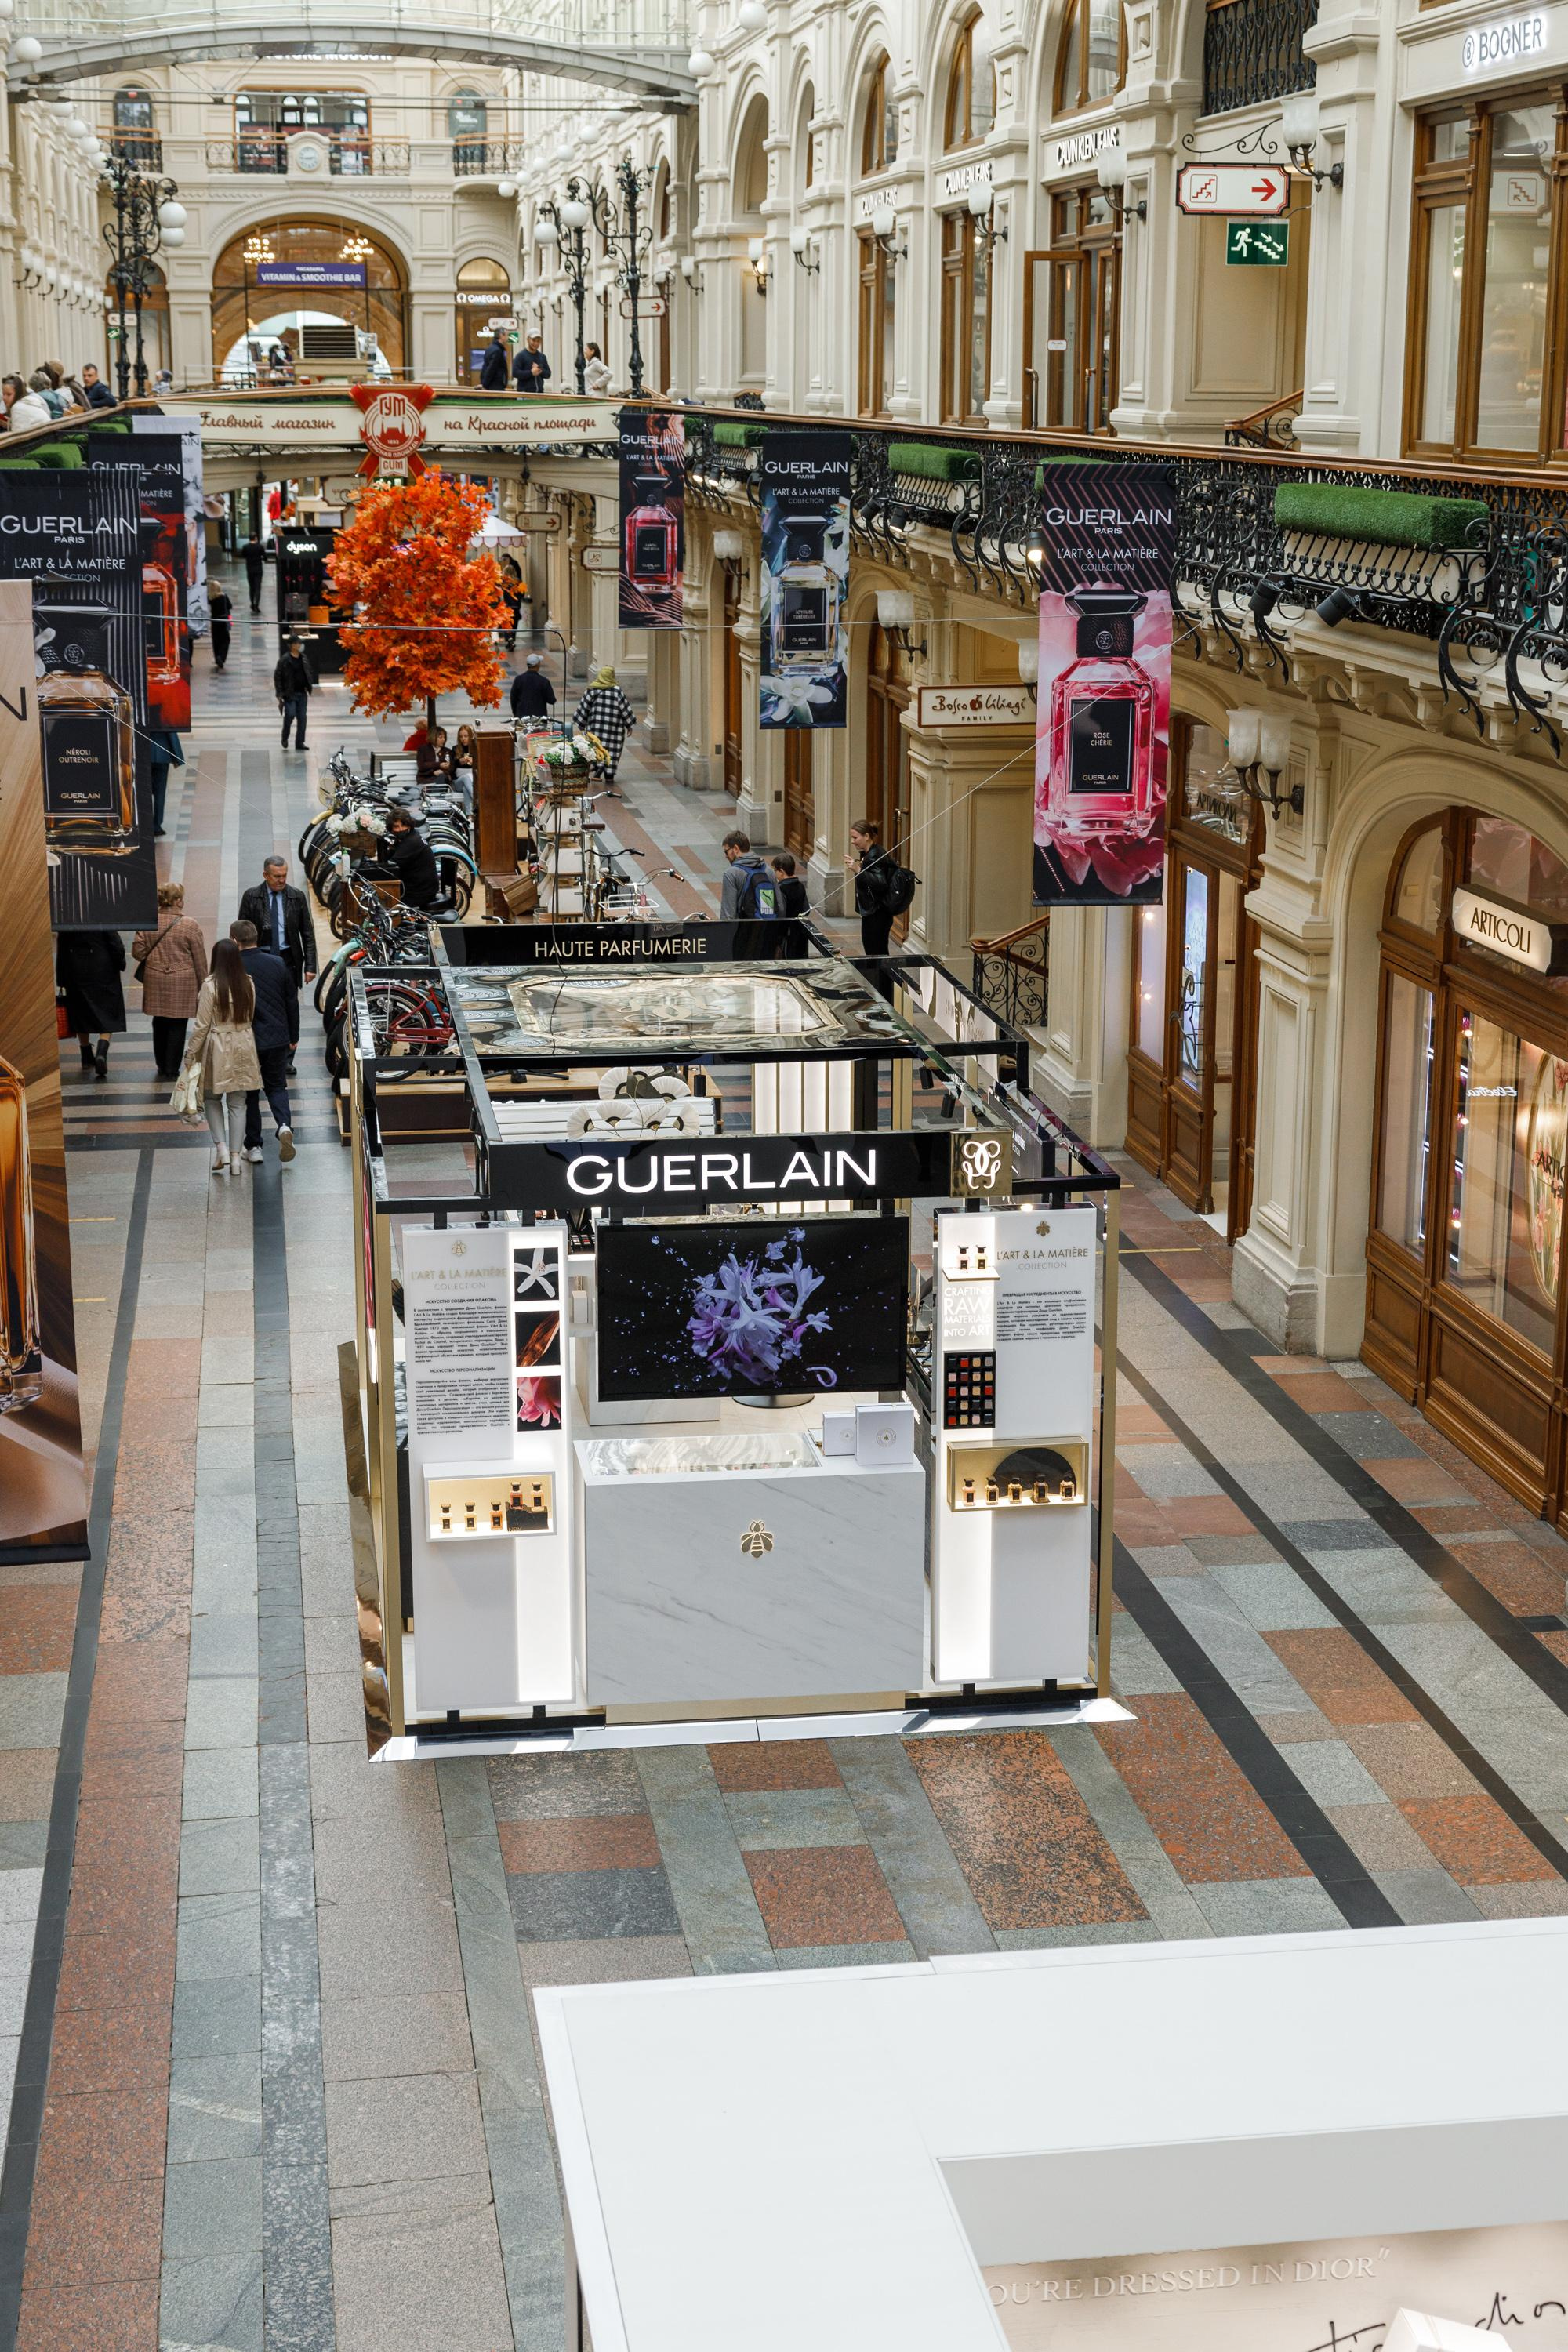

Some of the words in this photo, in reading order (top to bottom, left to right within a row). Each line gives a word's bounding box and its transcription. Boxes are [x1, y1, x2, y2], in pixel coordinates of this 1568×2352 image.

[1479, 18, 1542, 62] BOGNER
[1057, 137, 1079, 166] CALVIN
[261, 273, 296, 282] VITAMIN
[301, 274, 343, 282] SMOOTHIE
[344, 274, 361, 282] BAR
[468, 294, 500, 303] OMEGA
[199, 411, 264, 429] Главный
[271, 418, 336, 430] магазин
[444, 419, 463, 430] на
[467, 415, 530, 435] Красной
[534, 417, 597, 432] площади
[621, 434, 684, 445] GUERLAIN
[764, 461, 848, 474] GUERLAIN
[140, 489, 173, 499] MATIÈRE
[809, 486, 840, 495] MATIÈRE
[1046, 508, 1172, 525] GUERLAIN
[0, 514, 138, 535] GUERLAIN
[54, 535, 85, 544] PARIS
[286, 540, 318, 554] dyson
[1085, 549, 1094, 559] &
[1097, 550, 1110, 559] LA
[1113, 546, 1159, 559] MATIÈRE
[46, 557, 56, 569] &
[58, 557, 74, 569] LA
[76, 555, 126, 570] MATIÈRE
[1080, 563, 1134, 572] COLLECTION
[66, 747, 91, 756] NÉROLI
[58, 756, 100, 764] OUTRENOIR
[1470, 907, 1531, 954] ARTICOLI
[535, 941, 594, 958] HAUTE
[600, 938, 706, 956] PARFUMERIE
[566, 1149, 877, 1196] GUERLAIN
[1022, 1250, 1030, 1260] &
[1033, 1250, 1045, 1259] LA
[1047, 1246, 1089, 1258] MATIÈRE
[438, 1269, 446, 1279] &
[448, 1269, 462, 1279] LA
[464, 1265, 508, 1279] MATIÈRE
[1018, 1261, 1067, 1270] COLLECTION
[434, 1281, 487, 1291] COLLECTION
[943, 1296, 992, 1316] RAW
[944, 1314, 992, 1324] MATERIALS
[943, 1328, 966, 1337] INTO
[968, 1323, 992, 1337] ART
[987, 2278, 1085, 2307] OU'RE
[1093, 2265, 1241, 2299] DRESSED
[1250, 2263, 1288, 2285] IN
